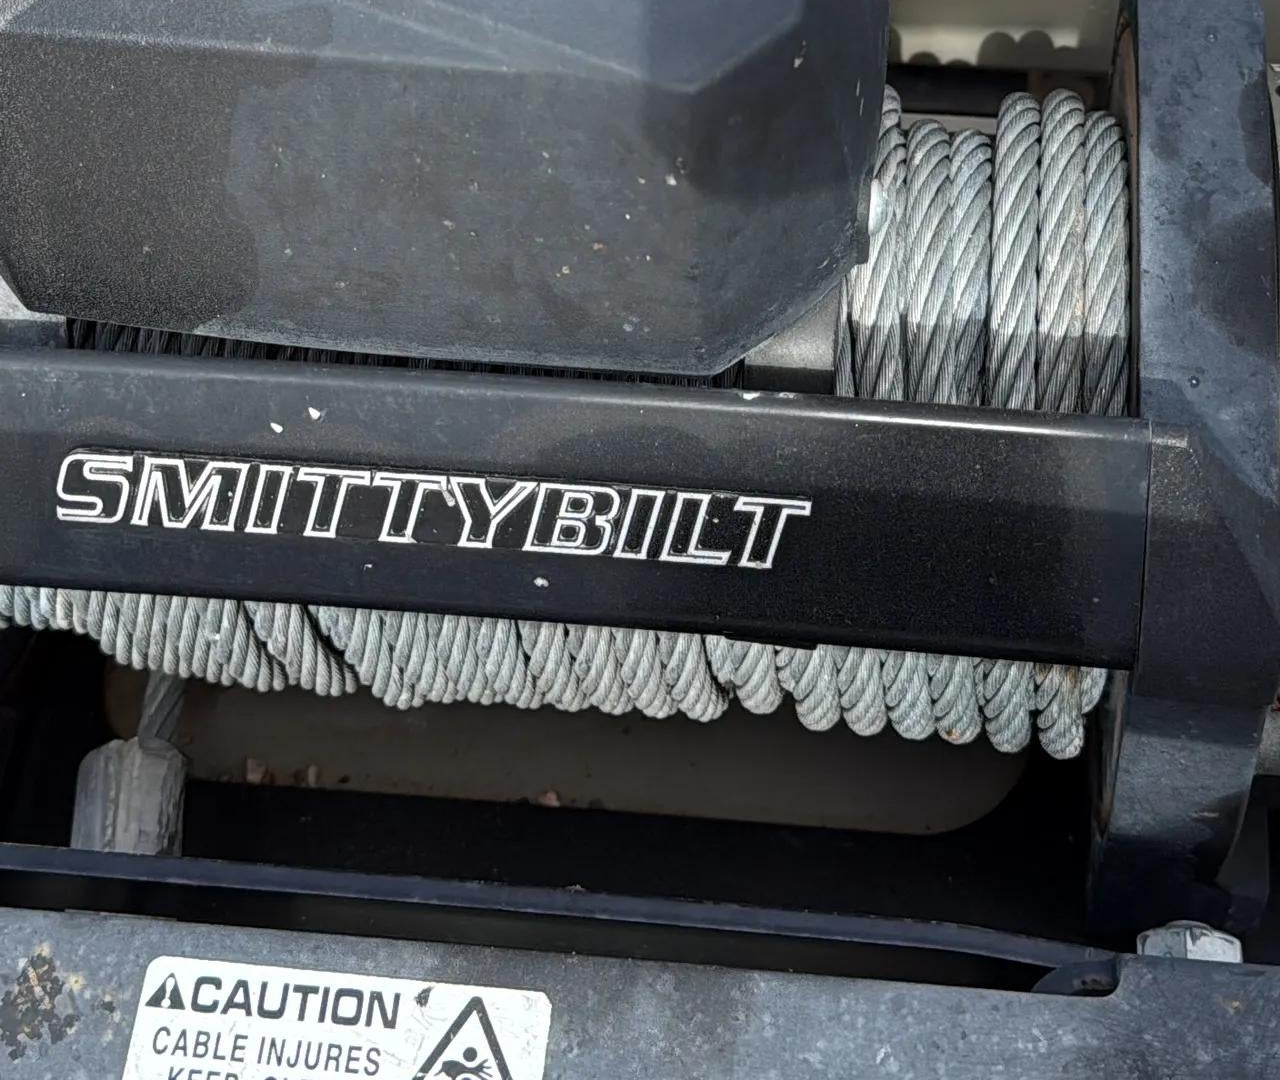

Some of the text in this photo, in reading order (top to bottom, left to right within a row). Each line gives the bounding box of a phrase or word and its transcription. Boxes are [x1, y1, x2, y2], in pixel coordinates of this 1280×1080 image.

[55, 452, 812, 570] SMITTYBILT
[190, 976, 402, 1030] CAUTION
[152, 1025, 383, 1077] CABLE INJURES
